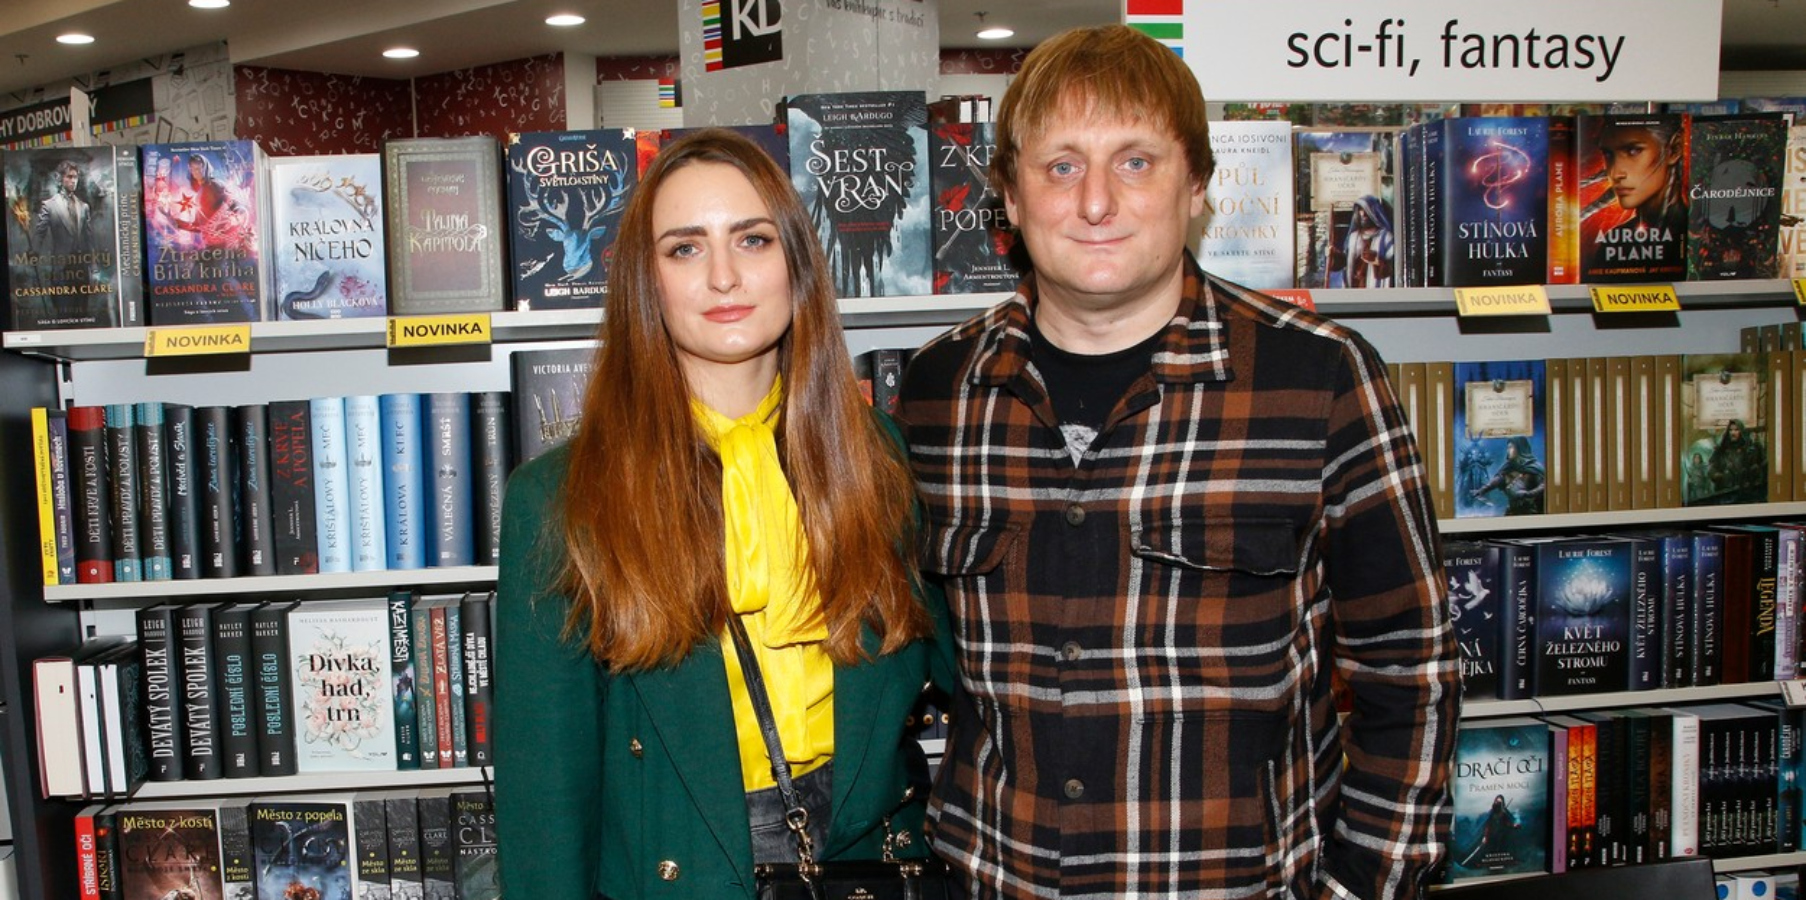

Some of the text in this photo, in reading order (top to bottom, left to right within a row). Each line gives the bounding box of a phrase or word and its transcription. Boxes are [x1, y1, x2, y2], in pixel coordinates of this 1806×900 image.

[1287, 18, 1626, 82] sci-fi, fantasy
[0, 94, 98, 137] HY DOBROVÝ
[1211, 134, 1287, 144] NCA IOSIVONI
[1498, 127, 1528, 136] FOREST
[527, 143, 618, 177] GRIŠA
[806, 134, 890, 174] ŠEST
[940, 146, 958, 168] Z
[580, 174, 609, 185] STÍNY
[1218, 161, 1266, 187] PŮL
[816, 174, 903, 213] VRAN
[1555, 162, 1564, 238] AURORA PLANE
[1690, 184, 1775, 200] ČARODĚJNICE
[1203, 192, 1279, 217] NOČNÍ
[289, 216, 375, 236] KRÁLOVNA
[941, 208, 1006, 232] POPE
[1459, 219, 1538, 239] STÍNOVÁ
[120, 194, 131, 277] Mechanický princ
[1201, 225, 1279, 240] KRONIKY
[1594, 228, 1673, 244] AURORA
[132, 224, 140, 277] CASSANDRA
[294, 238, 373, 261] NIČEHO
[1468, 241, 1529, 259] HŮLKA
[1605, 246, 1664, 262] PLANE
[154, 261, 254, 281] Bílá kniha
[15, 284, 113, 297] CASSANDRA CLARE
[154, 283, 217, 296] CASSANDRA
[222, 282, 256, 293] CLARE
[544, 285, 610, 297] LEIGH BARDUG
[292, 297, 378, 310] HOLLY BLACKOVÁ
[1470, 293, 1538, 307] NOVINKA
[1606, 293, 1673, 305] NOVINKA
[403, 322, 483, 338] NOVINKA
[166, 333, 243, 348] NOVINKA
[532, 364, 571, 375] VICTORIA
[174, 421, 186, 451] Slavík
[395, 421, 405, 454] KLEC
[440, 417, 451, 456] SMRŠŤ
[117, 434, 130, 476] POMSTY
[148, 431, 160, 475] POMSTY
[274, 420, 290, 479] Z KRVE
[291, 411, 307, 488] A POPELA
[177, 463, 188, 496] Medvěd
[441, 485, 454, 542] VÁLEČNÁ
[88, 519, 100, 543] DĚTI
[123, 528, 135, 552] DĚTI
[153, 526, 165, 550] DĚTI
[1456, 557, 1482, 567] FOREST
[1559, 549, 1613, 559] LAURIE FOREST
[1756, 576, 1776, 637] LEGENDA
[143, 618, 165, 629] LEIGH
[182, 617, 204, 628] LEIGH
[447, 615, 458, 641] MASKA
[1564, 625, 1604, 641] KVĚT
[1545, 640, 1620, 655] ŽELEZNÉHO
[309, 653, 381, 677] Dívka,
[434, 641, 447, 674] ZLATÁ
[1557, 656, 1608, 669] STROMU
[225, 654, 247, 737] POSLEDNÍ ČÍSLO
[260, 652, 282, 735] POSLEDNÍ ČÍSLO
[322, 679, 371, 698] had,
[146, 649, 174, 758] DEVÁTÝ SPOLEK
[184, 647, 212, 757] DEVÁTÝ SPOLEK
[327, 705, 361, 722] trn
[1457, 757, 1511, 780] DRAČÍ
[1516, 754, 1543, 774] OČI
[1469, 782, 1504, 792] PRAMEN
[457, 800, 484, 810] Město
[123, 815, 213, 830] Město z kostí
[257, 808, 343, 823] Město z popela
[458, 814, 496, 825] CASS
[82, 834, 93, 850] OČI
[423, 831, 447, 839] CLARE
[460, 846, 498, 855] NÁSTRO
[226, 866, 249, 874] Město
[361, 860, 384, 868] Město
[370, 865, 385, 873] skla
[394, 857, 416, 865] Město
[403, 864, 417, 872] skla
